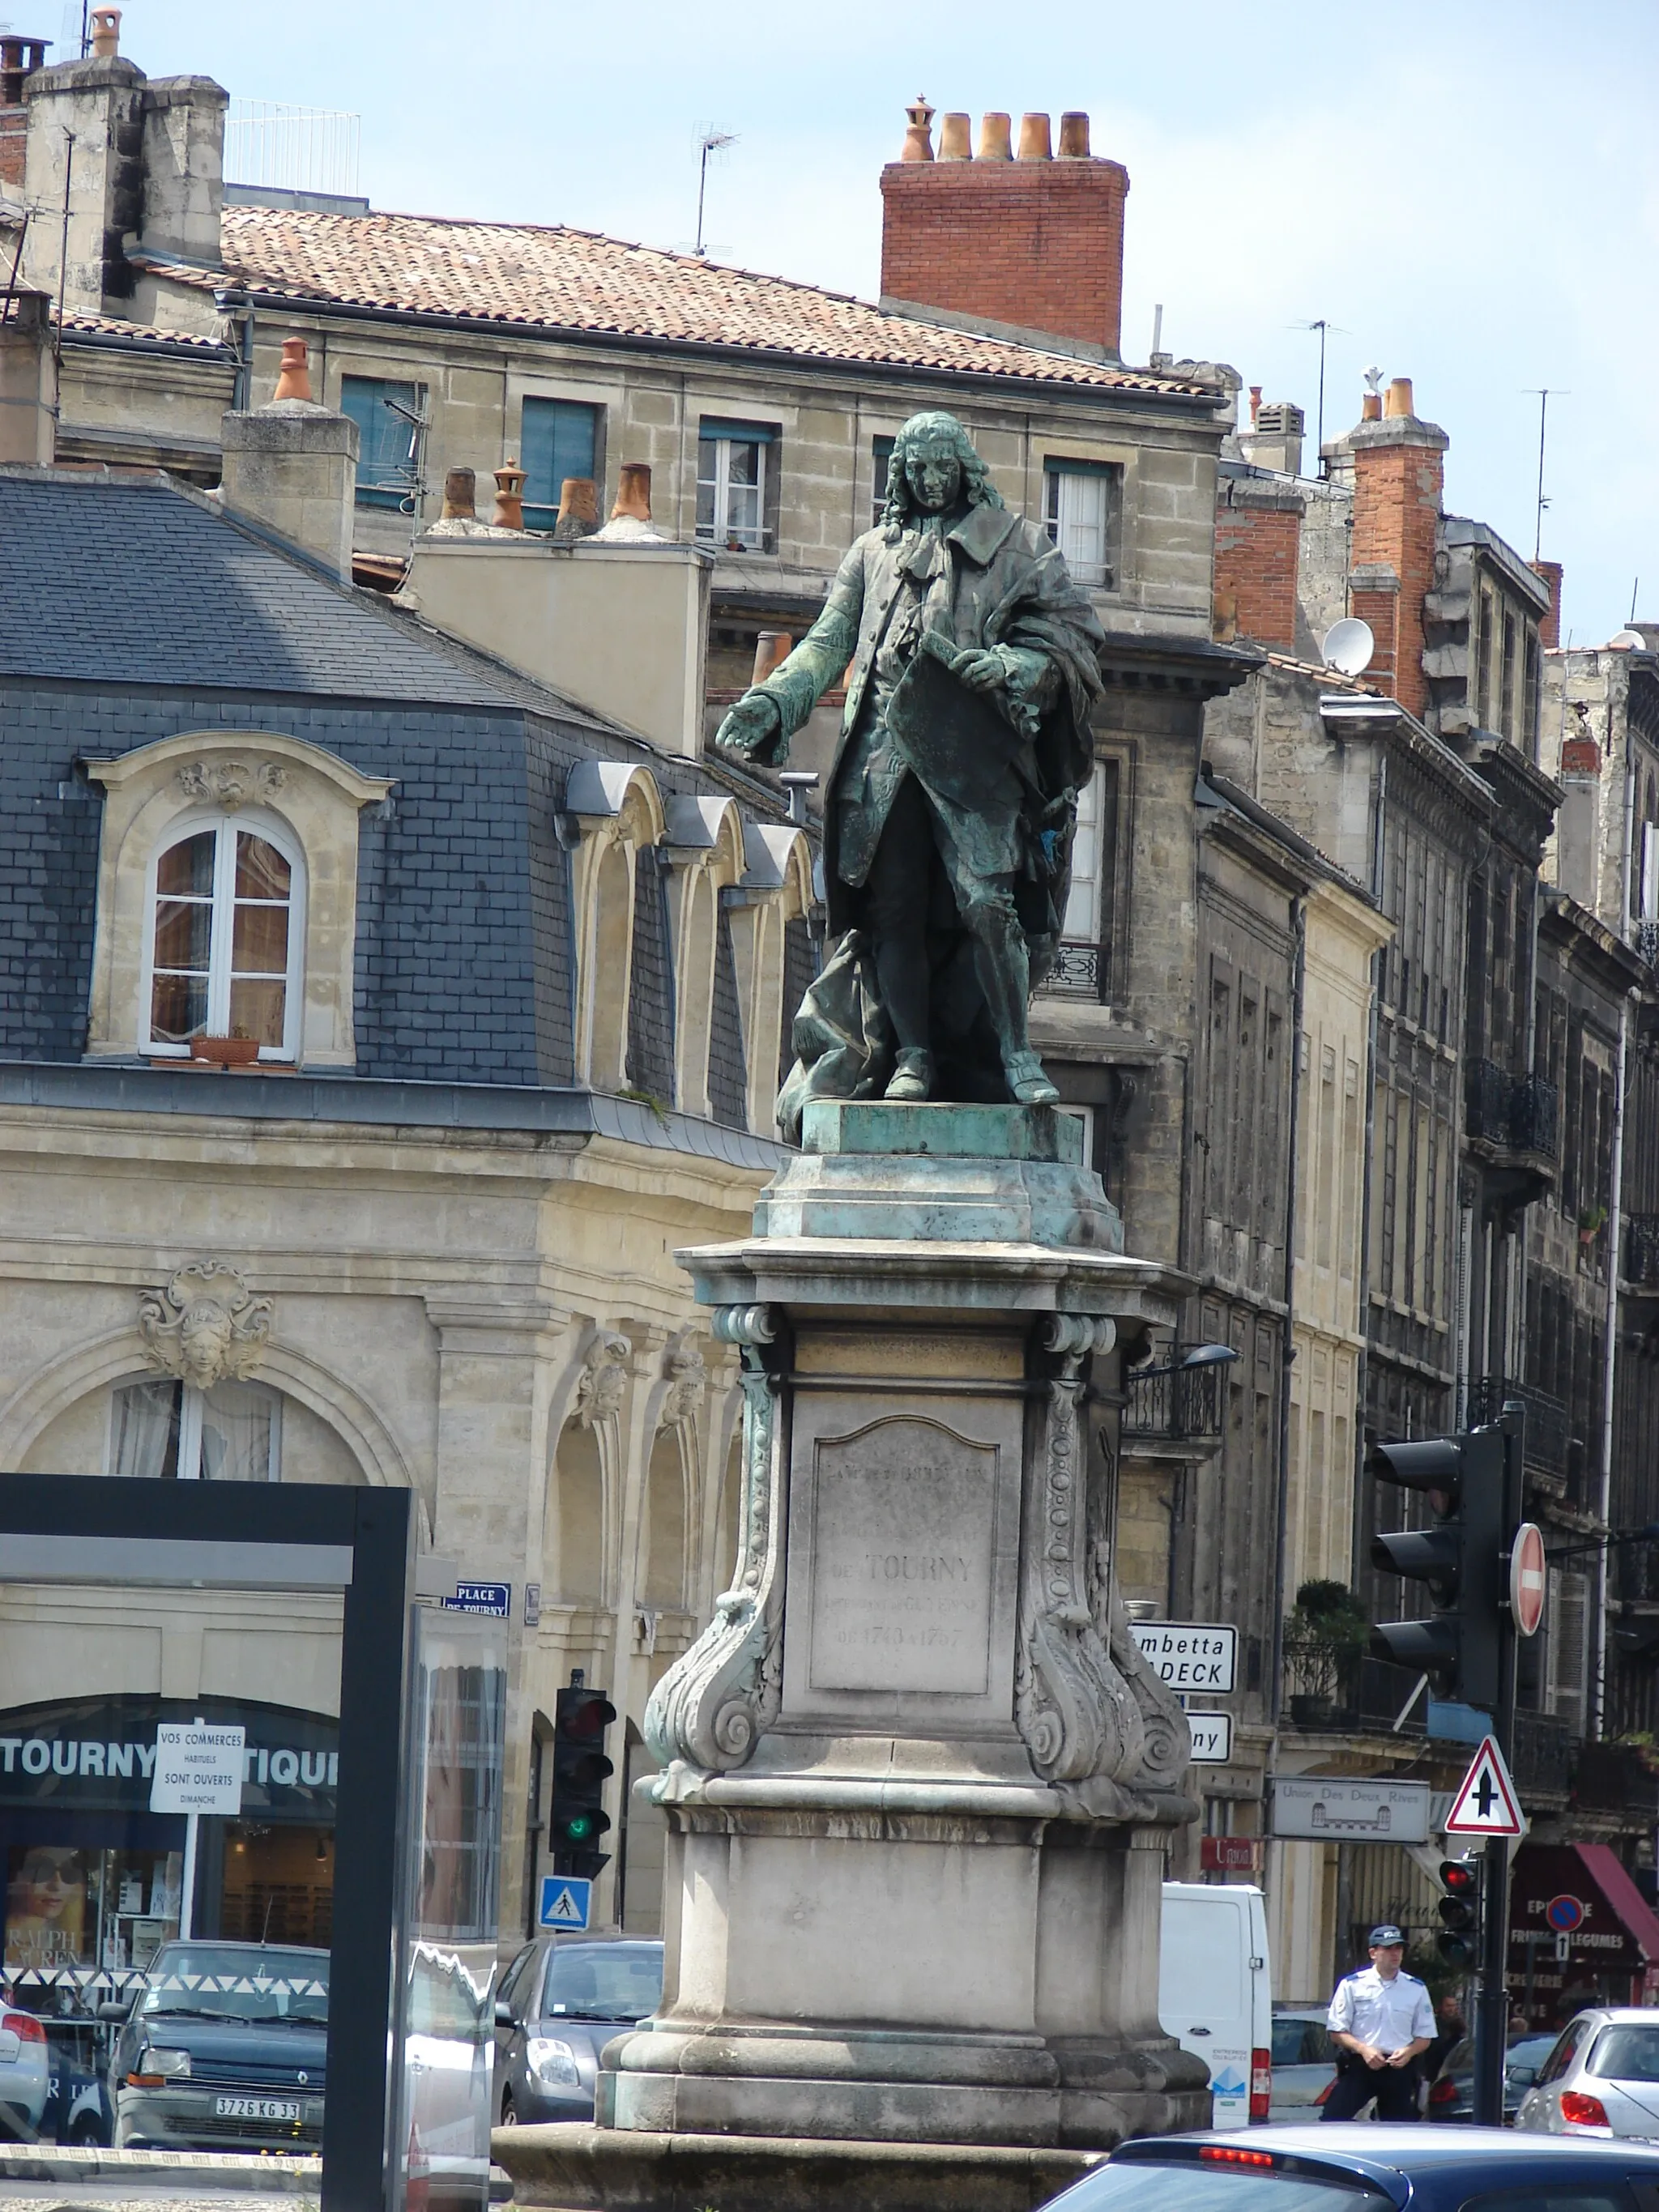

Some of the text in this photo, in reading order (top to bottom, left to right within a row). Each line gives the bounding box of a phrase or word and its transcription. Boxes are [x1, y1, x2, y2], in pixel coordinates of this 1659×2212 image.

[865, 1554, 971, 1582] TOURNY
[458, 1588, 495, 1601] PLACE
[1132, 1634, 1224, 1656] mbetta
[1149, 1662, 1222, 1684] DECK
[160, 1733, 241, 1746] VOS COMMERCES
[0, 1737, 157, 1778] TOURNY
[184, 1754, 216, 1764] HABITUELS
[164, 1773, 233, 1786] SONT OUVERTS
[180, 1795, 216, 1805] DIMANCHE
[1283, 1785, 1419, 1803] Union Des Deux Rives
[8, 1929, 75, 1950] RALPH
[219, 2099, 297, 2119] 3726 KG 33
